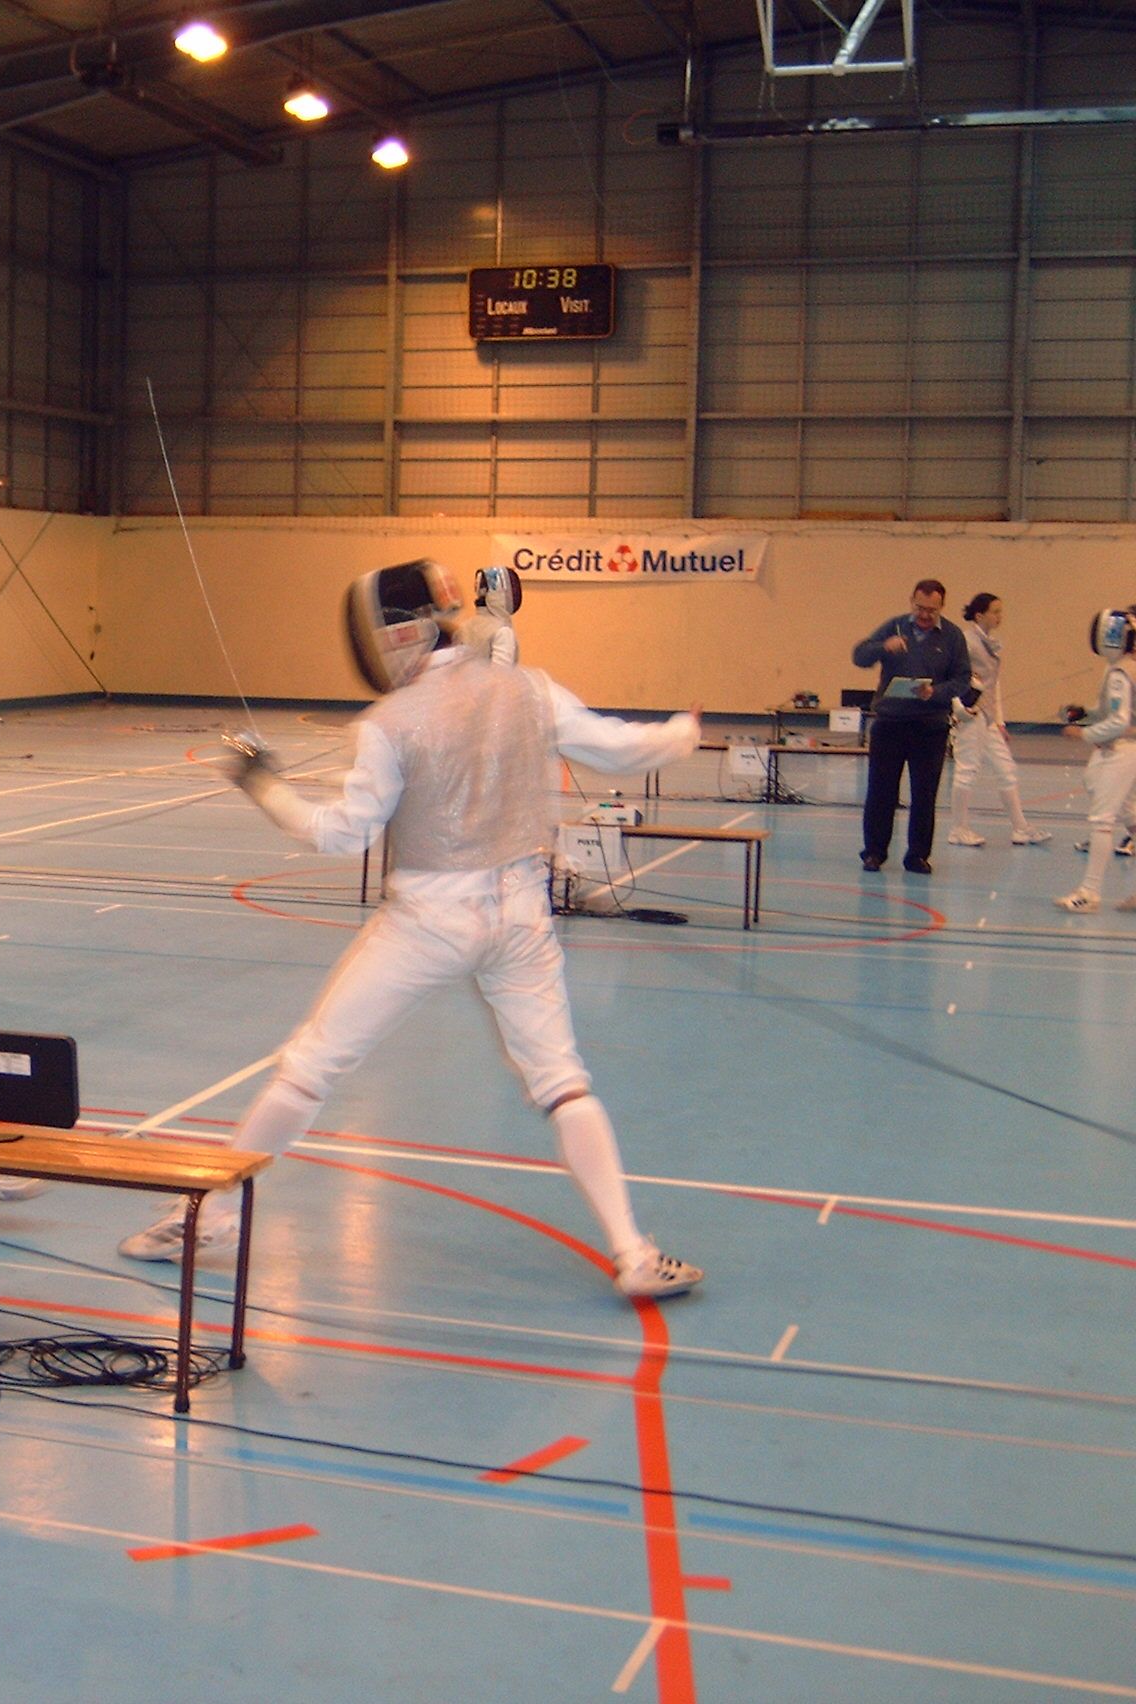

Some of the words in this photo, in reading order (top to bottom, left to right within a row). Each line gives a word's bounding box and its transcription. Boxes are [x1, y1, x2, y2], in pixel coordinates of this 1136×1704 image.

[514, 268, 577, 289] 10:38
[513, 548, 603, 571] Crédit
[641, 549, 745, 572] Mutuel
